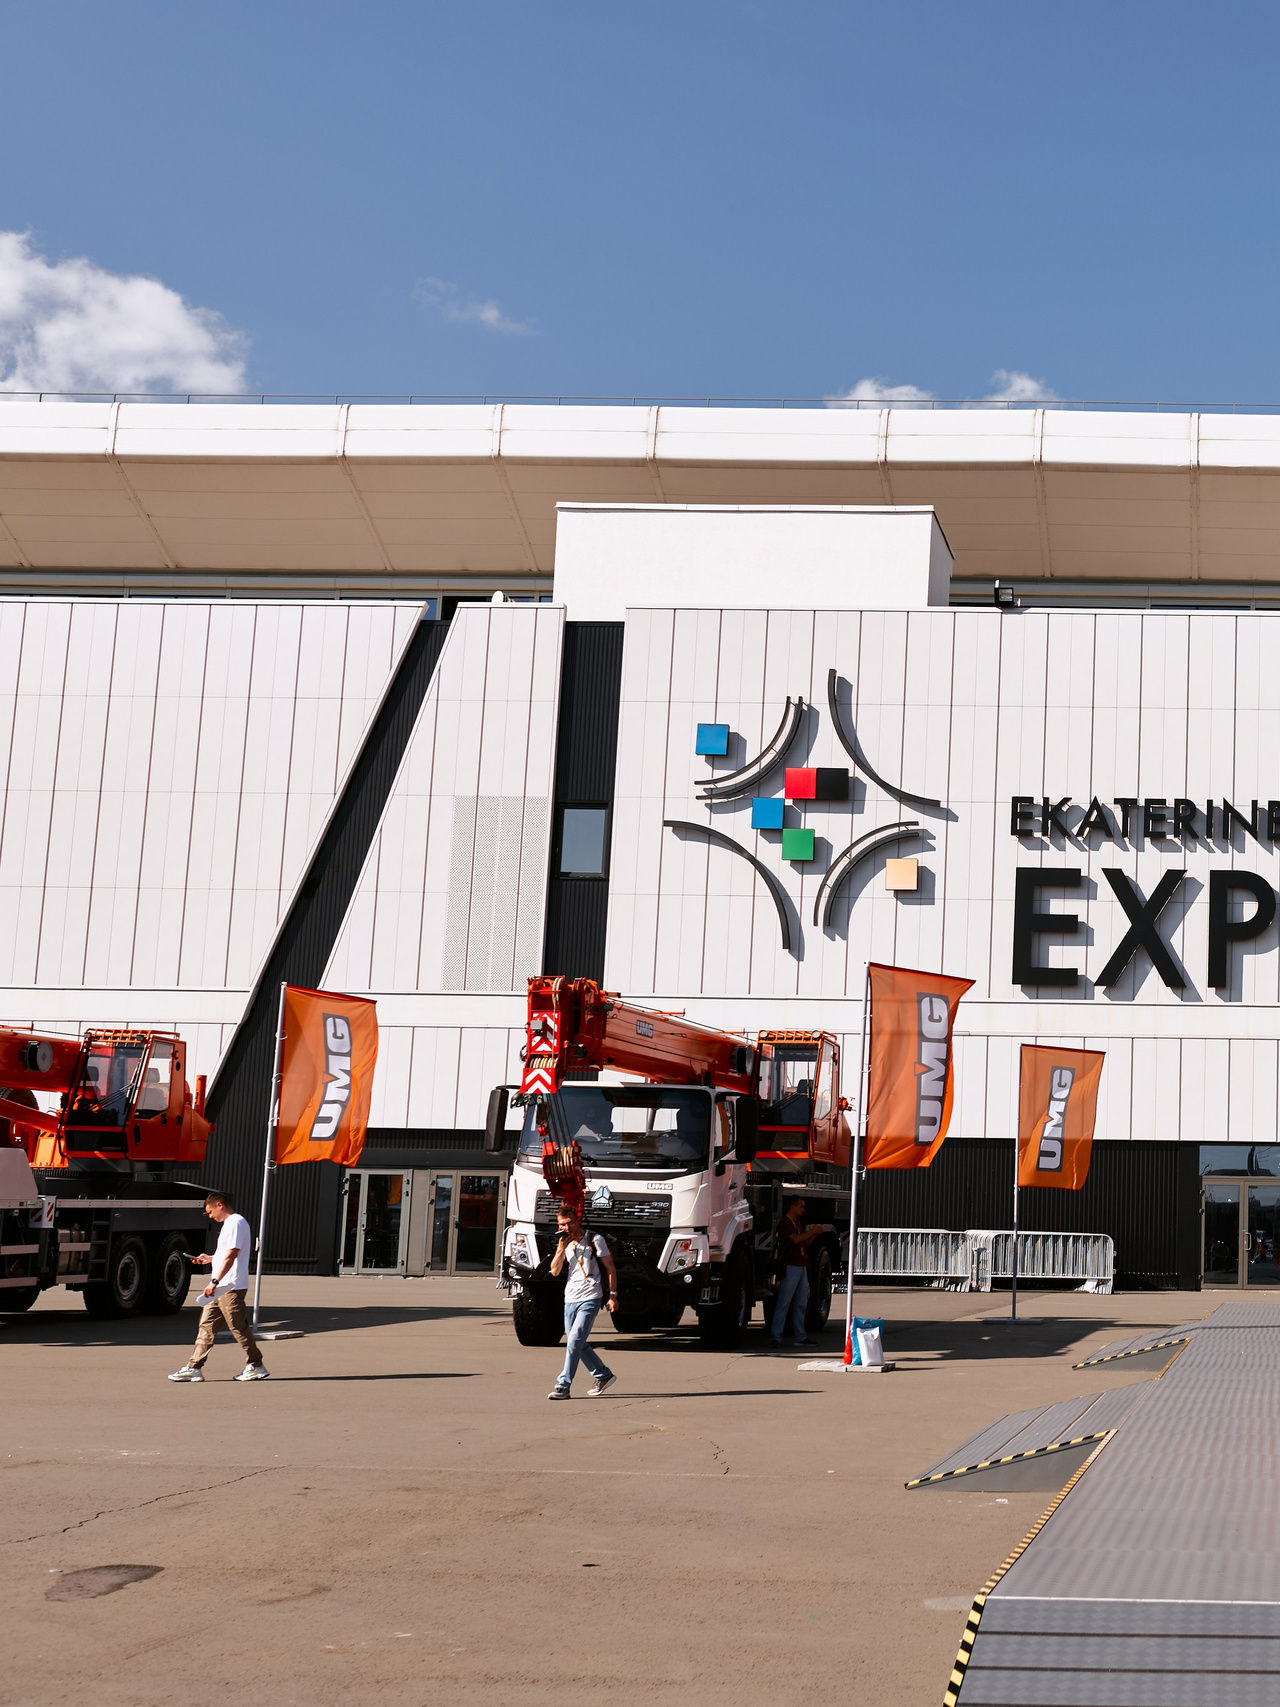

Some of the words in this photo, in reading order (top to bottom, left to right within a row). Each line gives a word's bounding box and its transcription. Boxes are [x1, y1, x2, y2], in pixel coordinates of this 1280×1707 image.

[311, 1016, 351, 1138] UMG
[917, 996, 949, 1142] UMG
[1038, 1068, 1073, 1169] UMG
